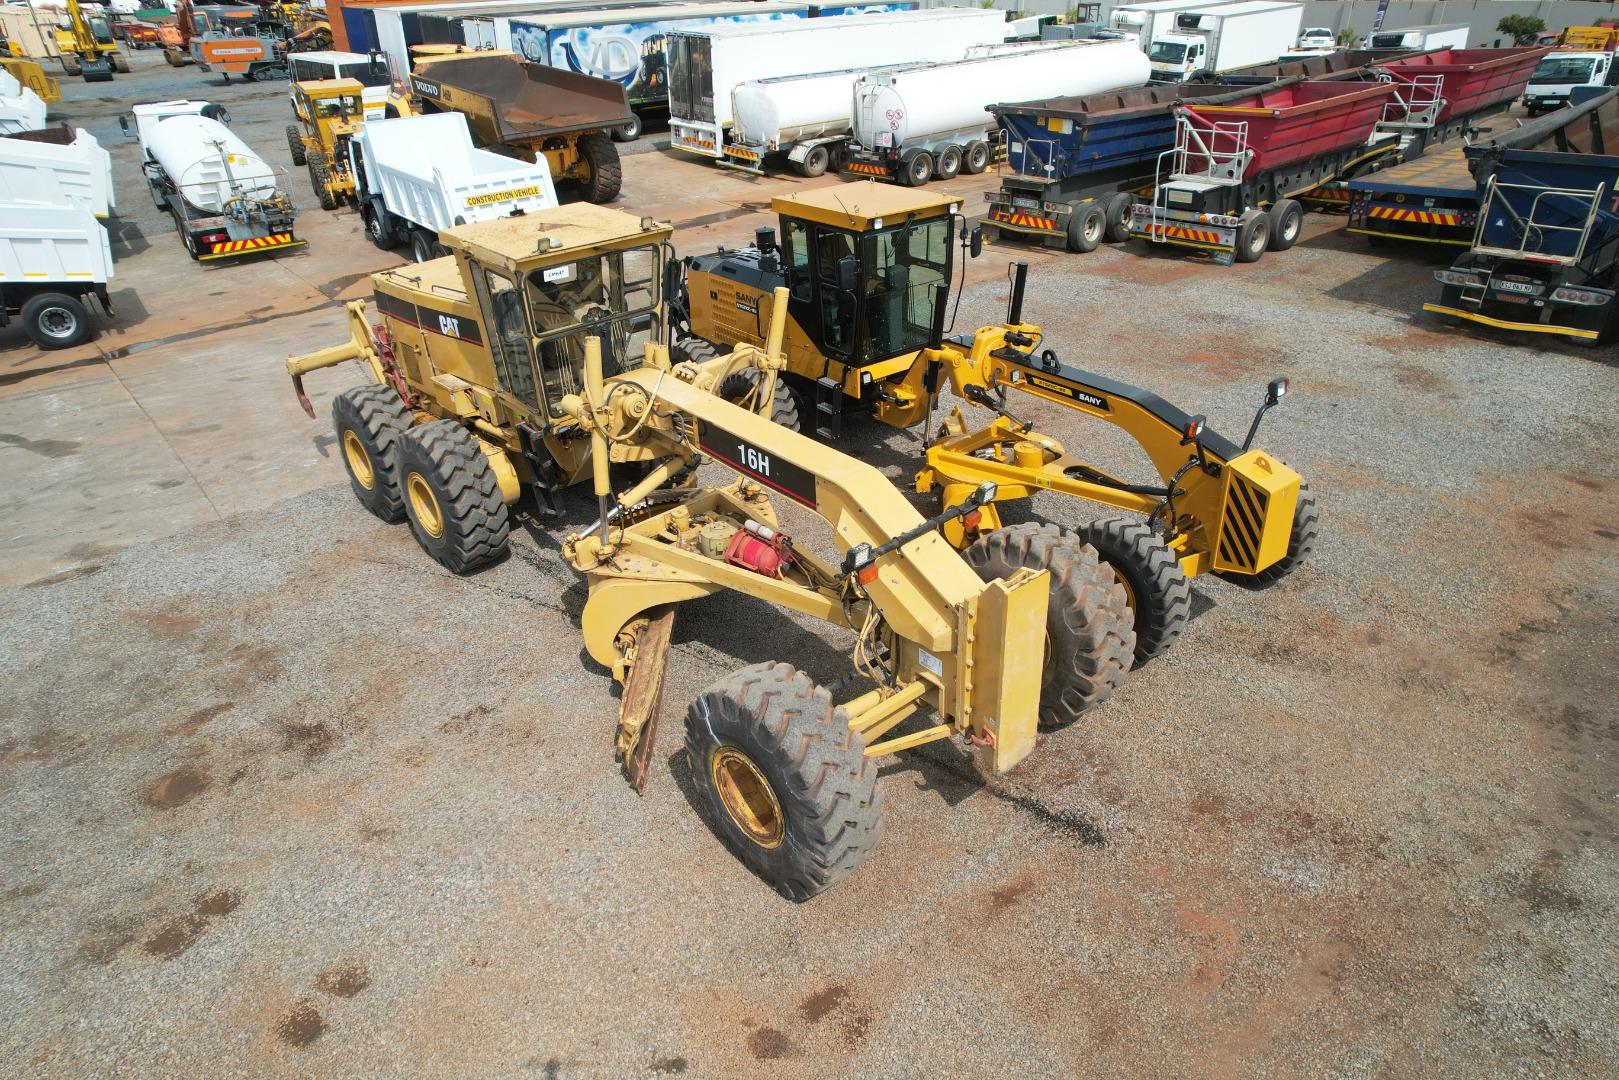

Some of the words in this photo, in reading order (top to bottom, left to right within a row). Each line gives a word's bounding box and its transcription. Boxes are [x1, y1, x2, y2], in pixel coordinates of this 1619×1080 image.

[414, 80, 439, 96] VOLVO
[467, 192, 514, 206] CONSTRUCTION
[514, 186, 540, 198] VEHICLE
[735, 290, 757, 305] SANY
[438, 314, 460, 338] CAT
[1078, 393, 1102, 406] SANY
[737, 444, 770, 477] 16H
